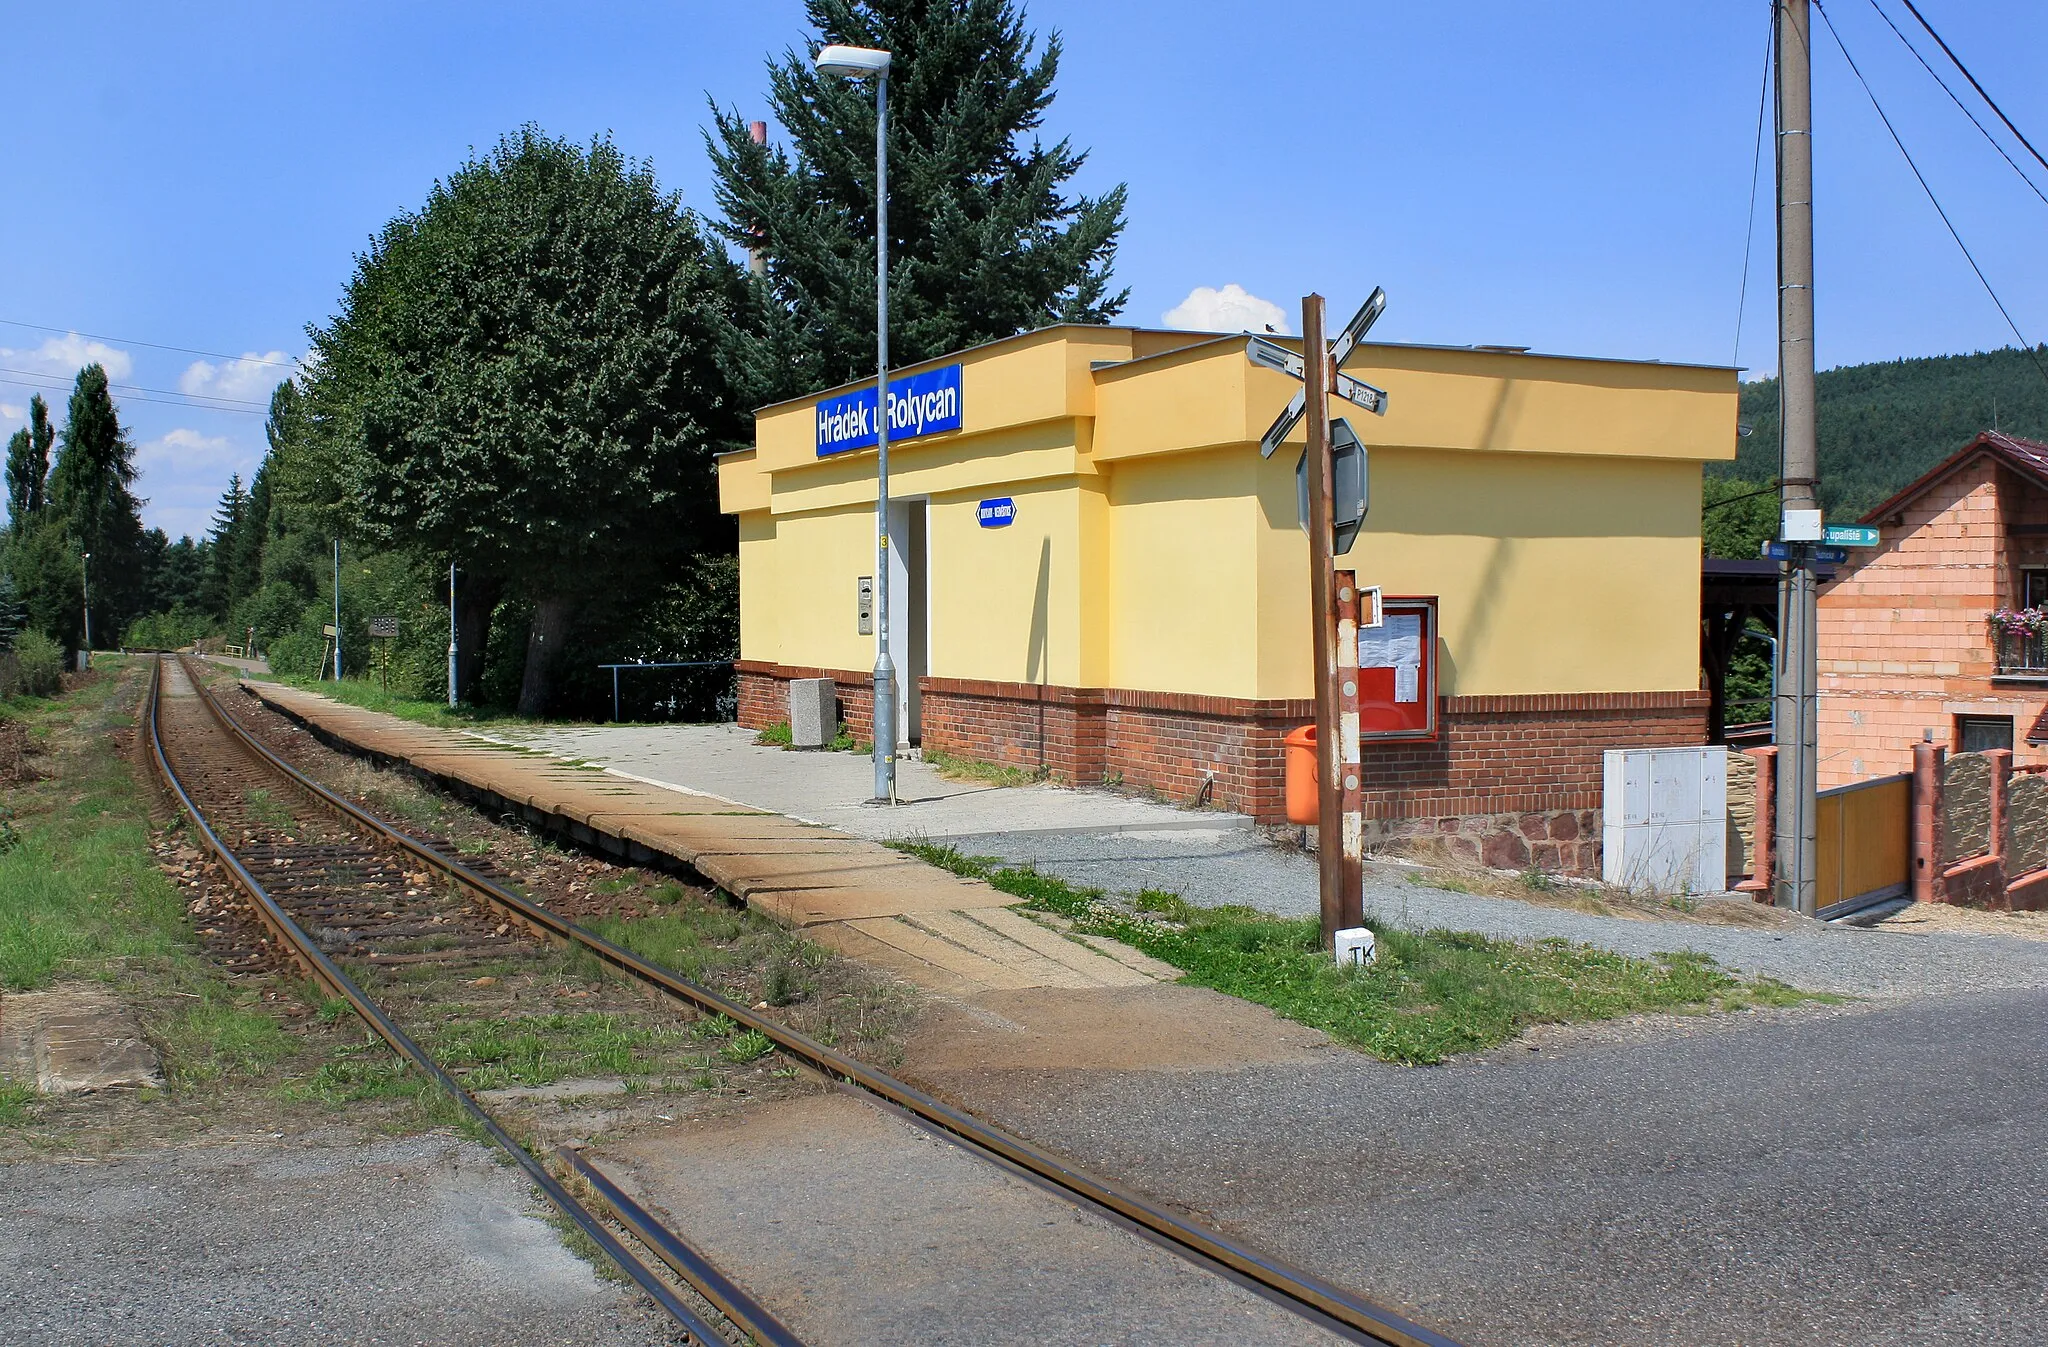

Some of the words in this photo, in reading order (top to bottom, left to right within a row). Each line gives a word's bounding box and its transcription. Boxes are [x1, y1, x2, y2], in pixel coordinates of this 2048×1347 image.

[819, 400, 869, 445] Hrádek
[887, 386, 956, 435] Rokycan
[881, 537, 887, 547] 3
[1348, 944, 1375, 966] TK
